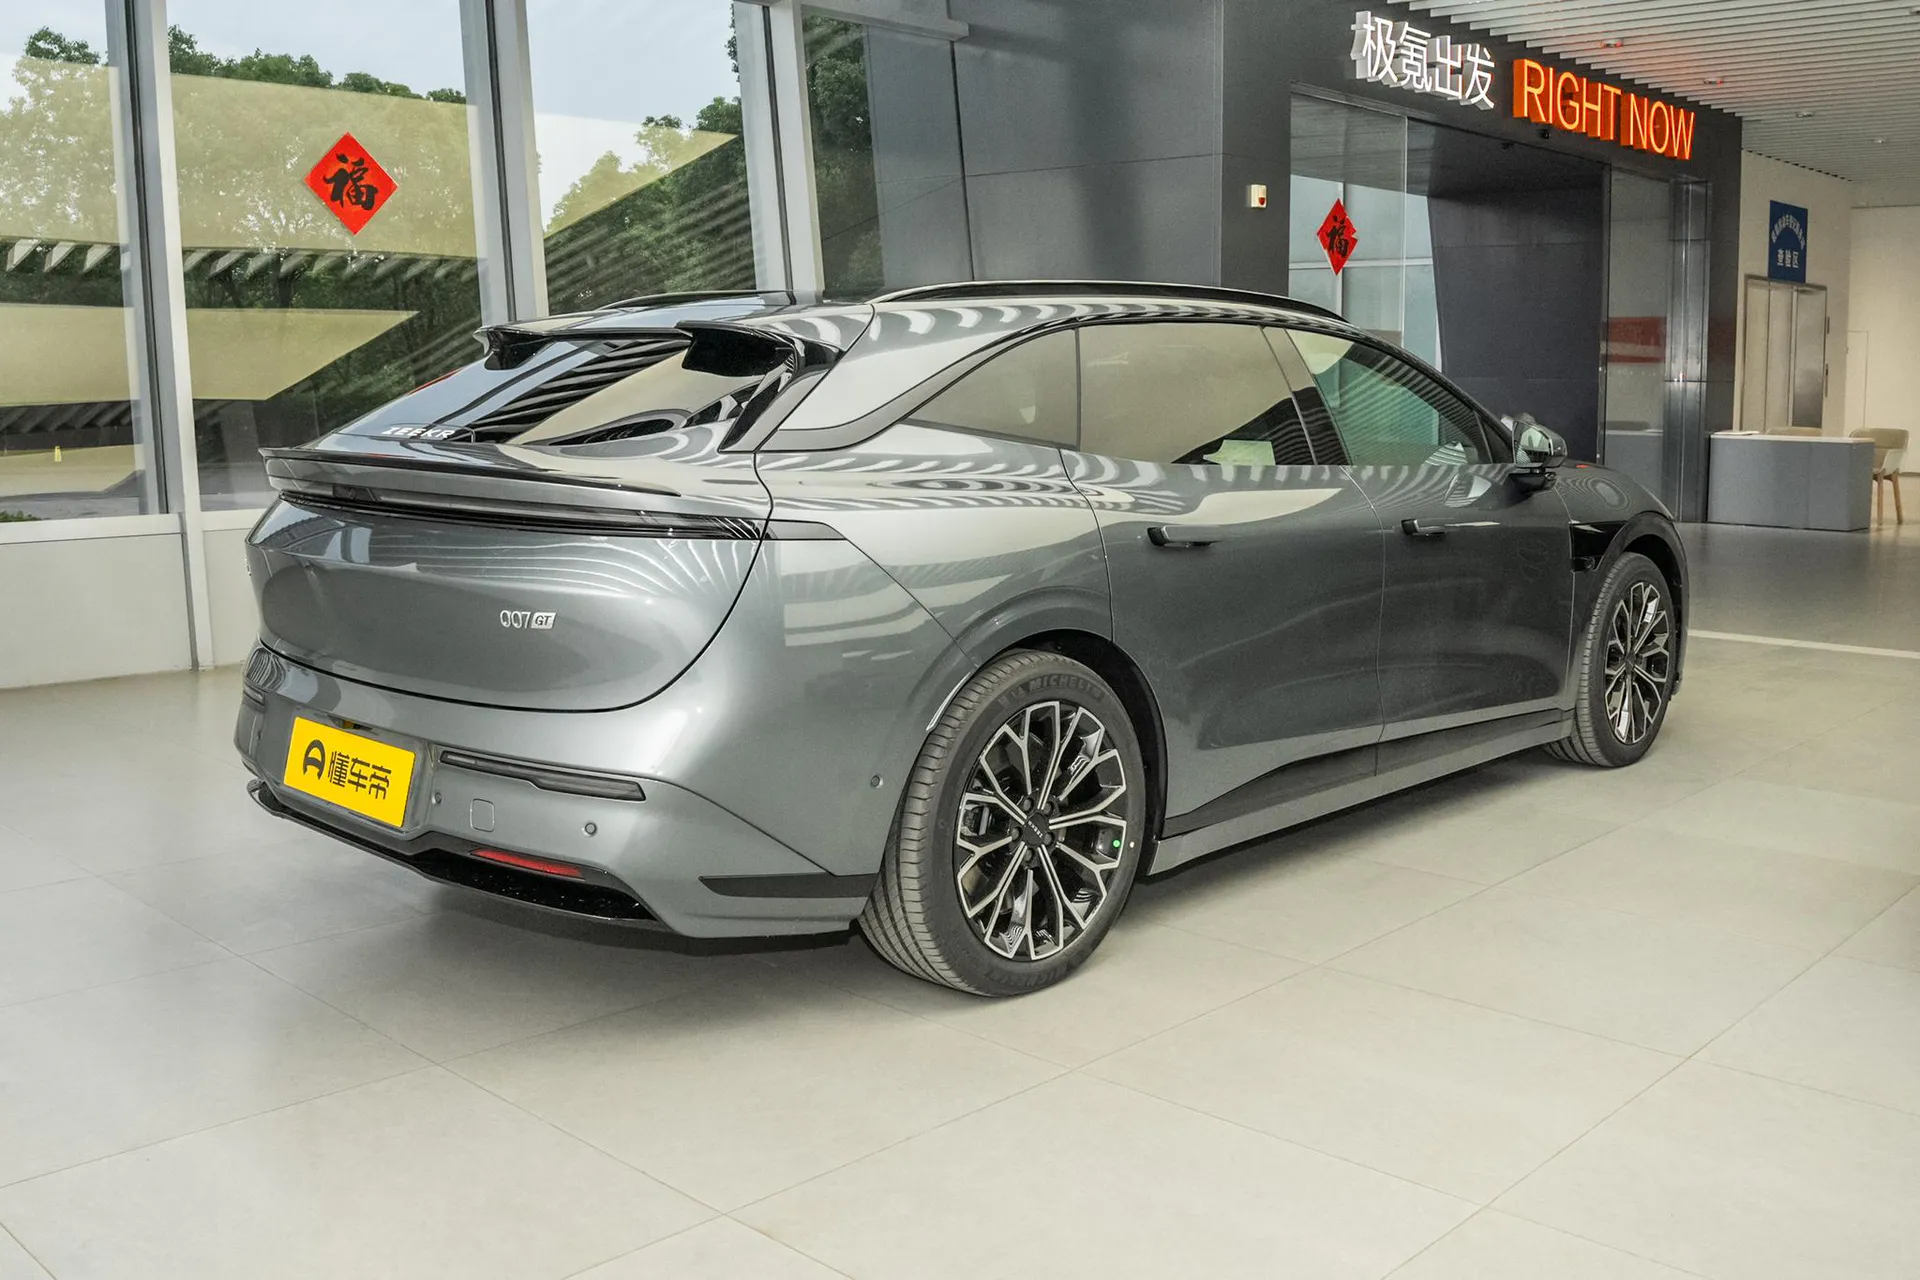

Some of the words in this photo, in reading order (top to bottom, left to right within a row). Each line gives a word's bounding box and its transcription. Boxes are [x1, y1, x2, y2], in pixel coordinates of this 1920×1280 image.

[1352, 11, 1495, 110] 极氪出发
[1515, 59, 1622, 140] RIGHT
[1623, 93, 1695, 160] NOW
[323, 153, 379, 210] 福
[1326, 215, 1349, 257] 福
[381, 427, 456, 438] ZEEKR
[500, 610, 531, 629] 007
[534, 614, 553, 627] GT
[328, 751, 392, 800] 懂车帝
